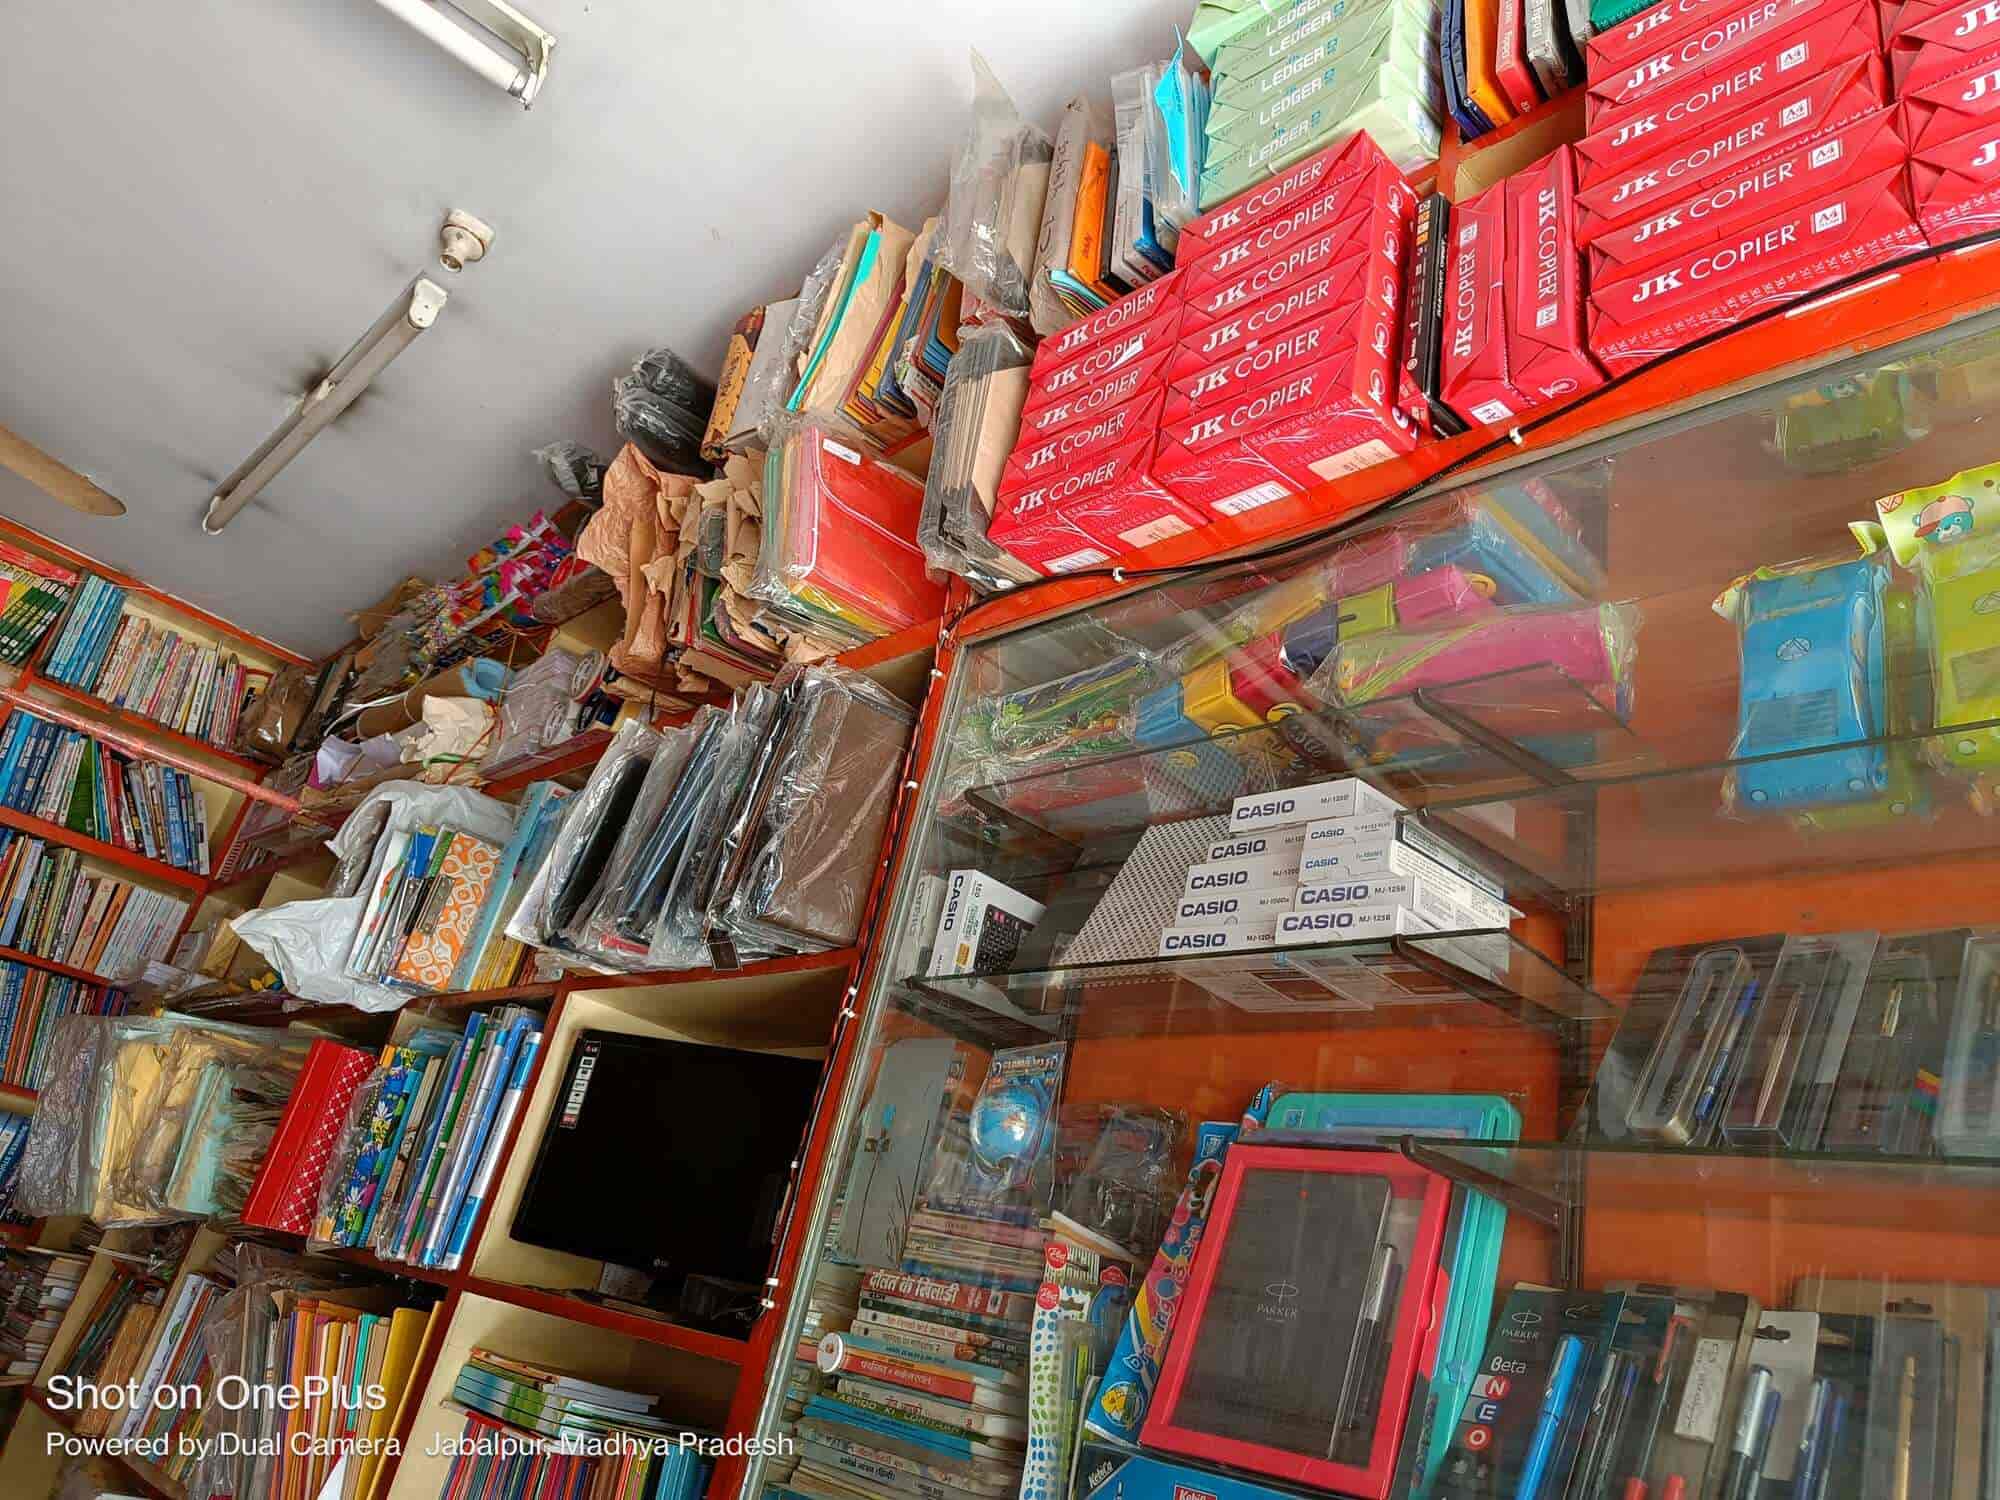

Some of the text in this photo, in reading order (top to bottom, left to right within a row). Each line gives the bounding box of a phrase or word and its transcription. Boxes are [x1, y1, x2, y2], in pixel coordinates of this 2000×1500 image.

[1265, 0, 1321, 36] LEDGE
[1268, 9, 1332, 57] LEDGER
[1627, 4, 1673, 40] JK
[1260, 47, 1325, 92] LEDGER
[1627, 3, 1778, 89] JK COPIER
[1259, 77, 1323, 125] LEDGER
[1611, 115, 1659, 147] JK
[1666, 66, 1764, 121] COPIER
[1248, 119, 1309, 167] LEDGER
[1612, 169, 1660, 203] JK
[1666, 121, 1766, 178] COPIER
[1203, 160, 1323, 238] JK COPIER
[1538, 188, 1556, 226] JK
[1632, 210, 1682, 243] JK
[1689, 161, 1794, 219] COPIER
[1212, 241, 1252, 272] JK
[1256, 195, 1335, 249] COPIER
[1207, 281, 1247, 312] JK
[1252, 236, 1333, 290] COPIER
[1457, 248, 1475, 321] COPIER
[1538, 226, 1557, 300] COPIER
[1632, 272, 1683, 303] JK
[1690, 224, 1797, 281] COPIER
[1056, 288, 1156, 353] JK COPIER
[1203, 318, 1242, 353] JK
[1248, 279, 1331, 331] COPIER
[1453, 320, 1473, 357] JK
[1046, 364, 1079, 392] JK
[1190, 330, 1320, 399] JK COPIER
[1036, 369, 1138, 429] JK COPIER
[1183, 377, 1314, 446] JK COPIER
[1024, 411, 1126, 470] JK COPIER
[1013, 461, 1116, 515] JK COPIER
[1236, 799, 1295, 820] CASIO
[1310, 827, 1345, 840] CASIO
[1211, 839, 1267, 860] CASIO
[1305, 856, 1339, 869] CASIO
[944, 875, 965, 931] CASIO
[1190, 871, 1248, 890] CASIO
[1300, 885, 1369, 904] CASIO
[1180, 899, 1238, 918] CASIO
[1282, 912, 1354, 932] CASIO
[1165, 933, 1226, 950] CASIO
[1256, 1304, 1299, 1320] PARKER
[1501, 1328, 1539, 1340] PARKER
[1490, 1356, 1527, 1374] Beta
